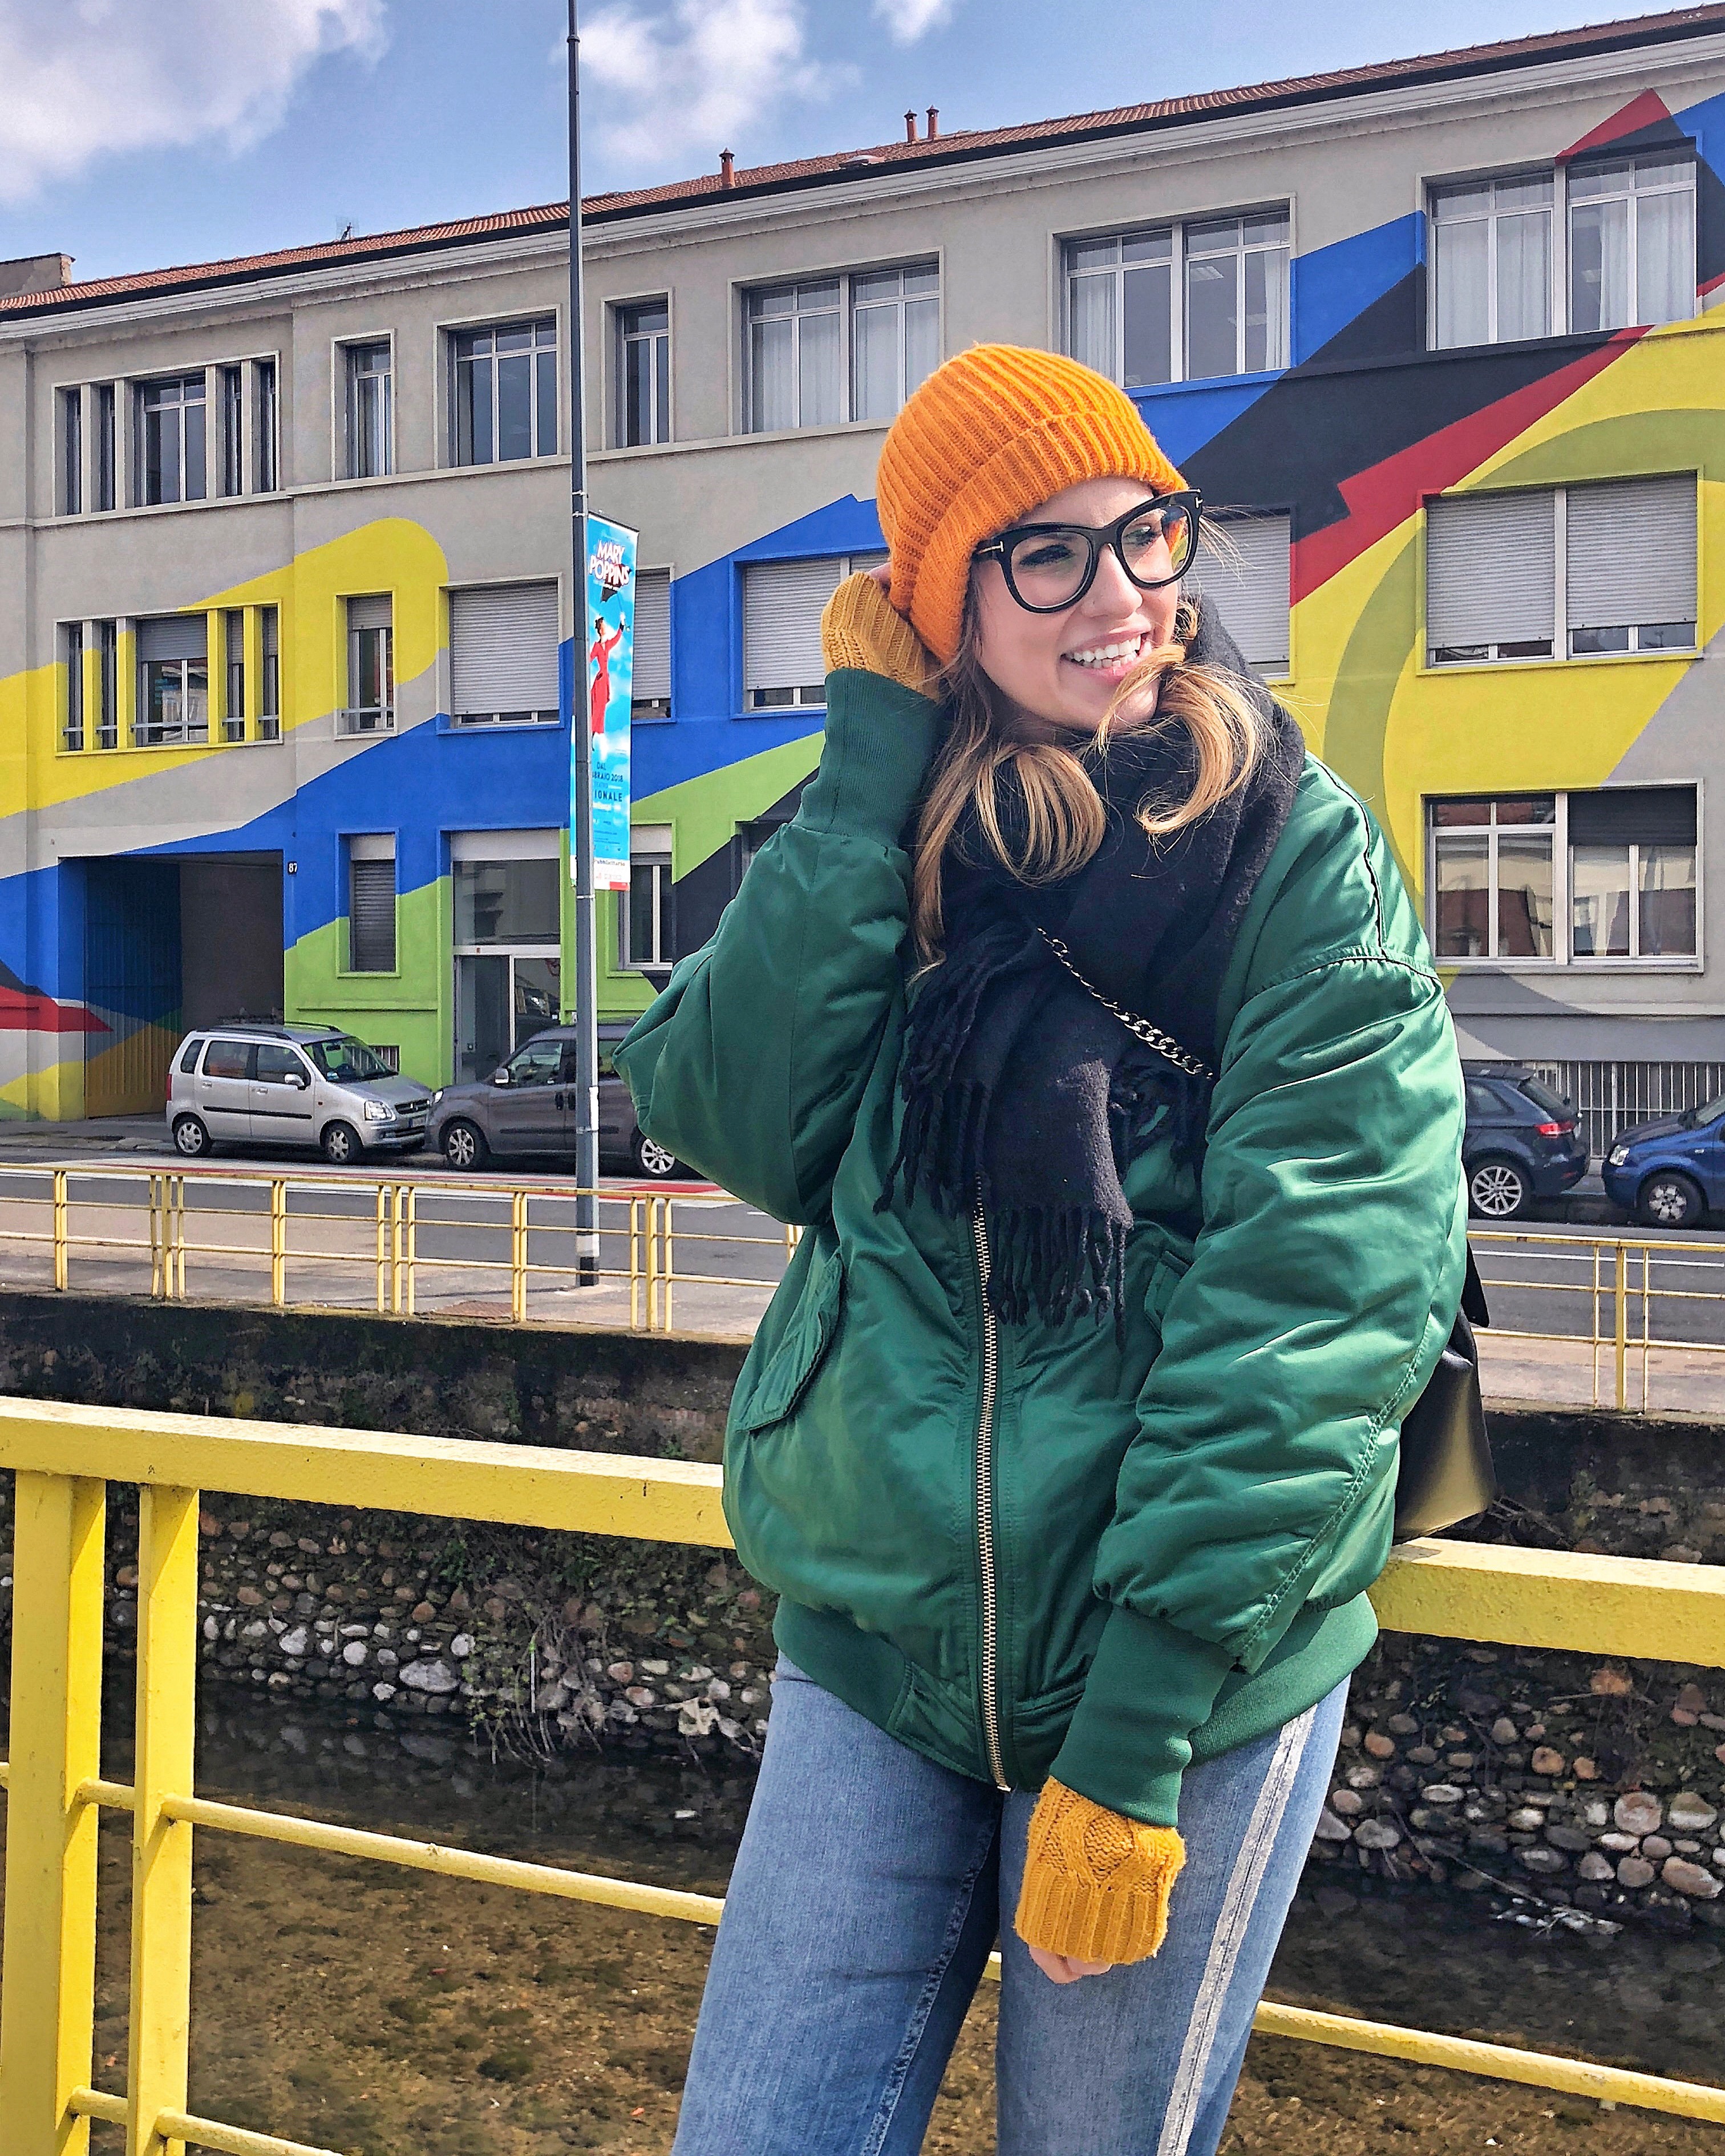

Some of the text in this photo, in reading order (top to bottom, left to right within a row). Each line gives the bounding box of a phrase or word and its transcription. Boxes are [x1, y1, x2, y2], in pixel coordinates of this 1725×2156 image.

[597, 539, 625, 564] MARY
[589, 554, 630, 586] POPPINS
[611, 773, 623, 783] 2018
[594, 789, 622, 802] IONALE
[289, 862, 297, 873] 87
